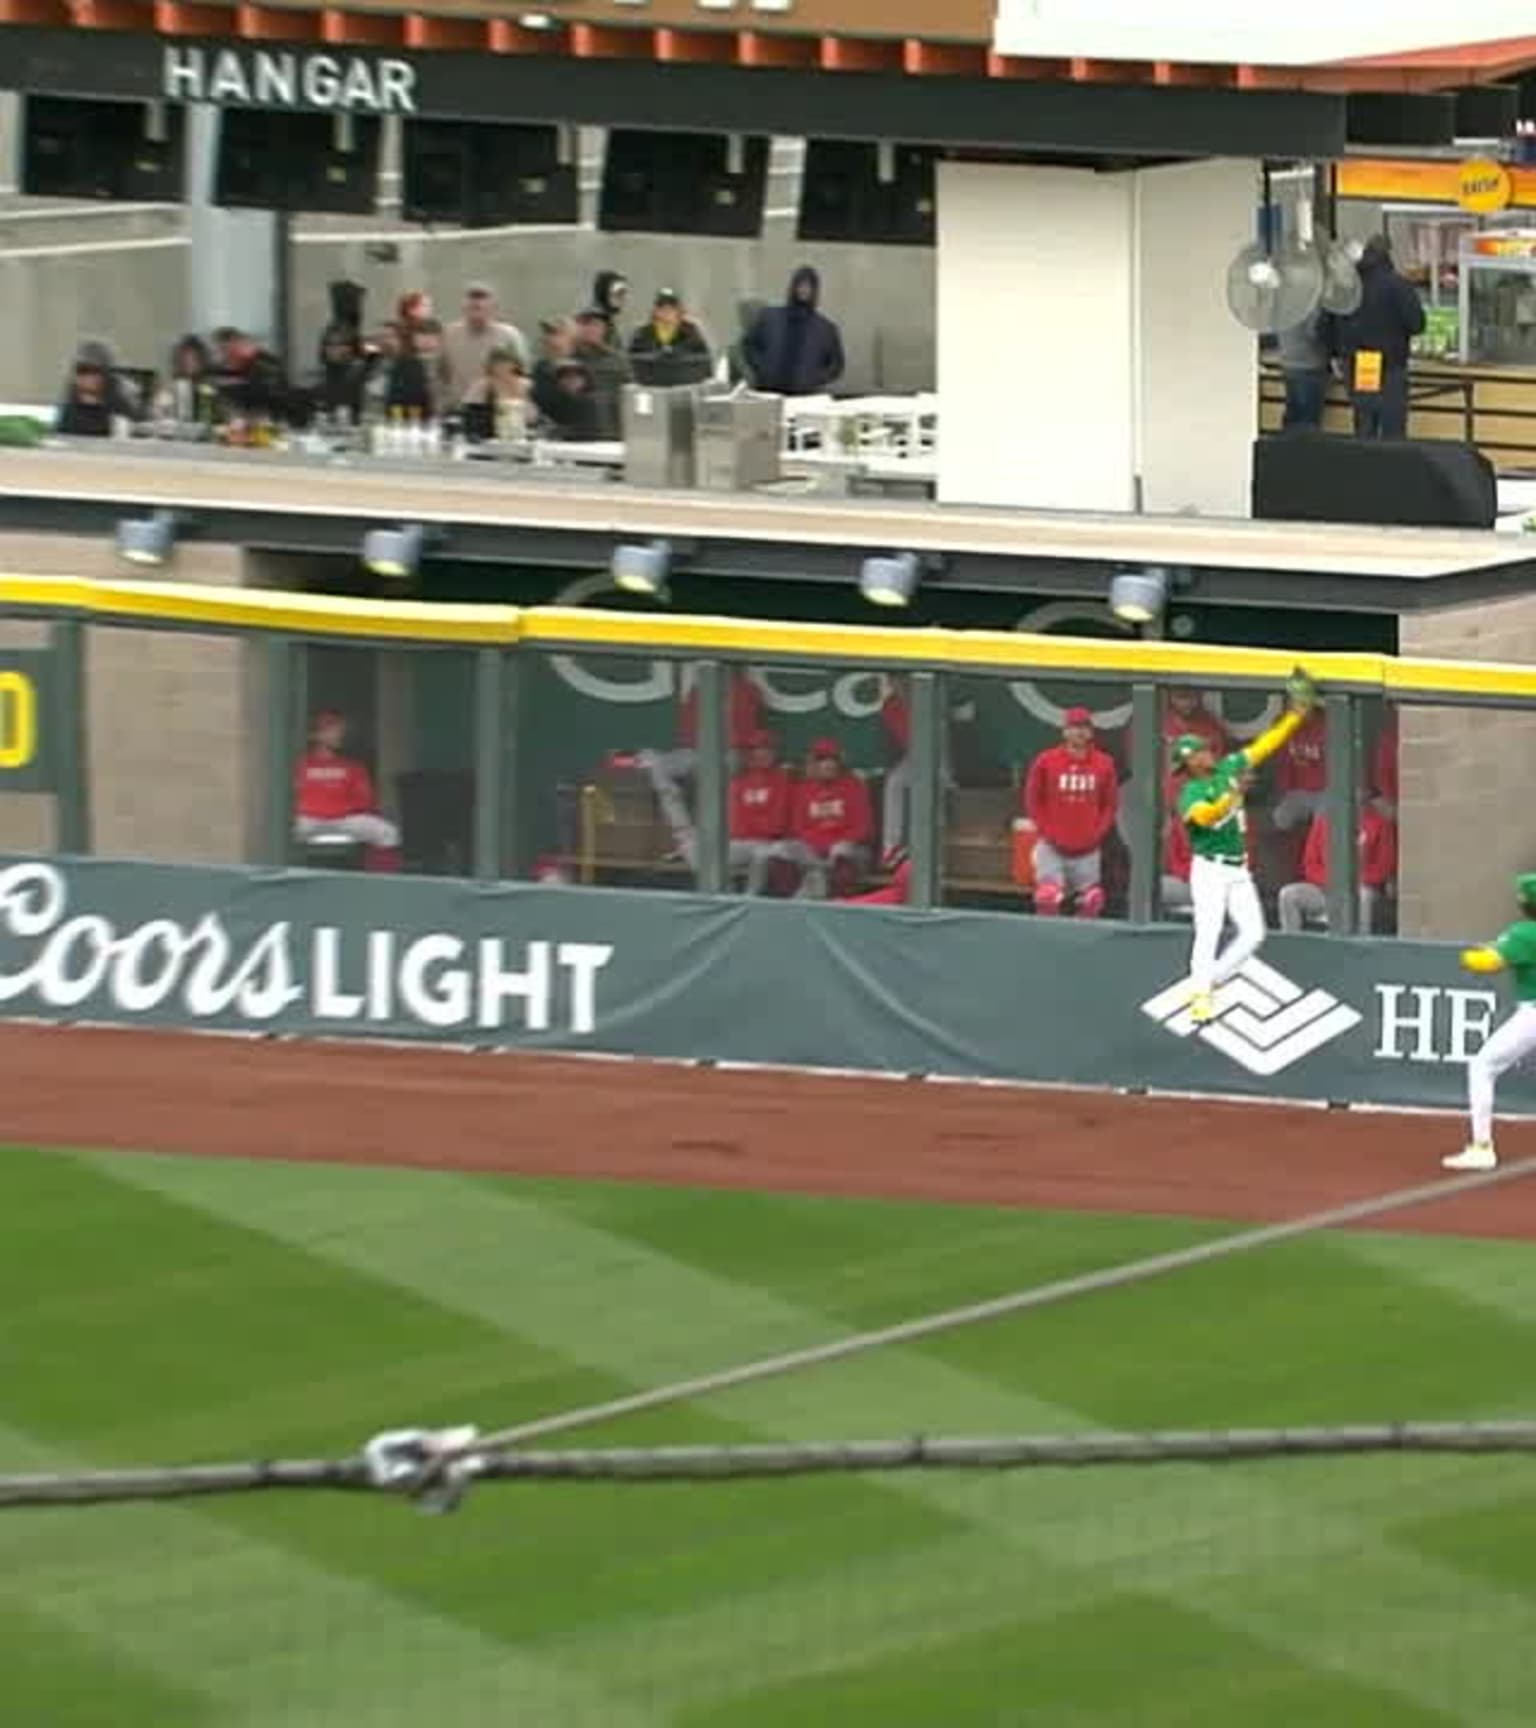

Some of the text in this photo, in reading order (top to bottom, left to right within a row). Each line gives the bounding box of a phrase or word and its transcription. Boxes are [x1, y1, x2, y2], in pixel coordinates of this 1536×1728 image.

[163, 45, 417, 113] HANGAR
[0, 863, 614, 1033] Coors LIGHT
